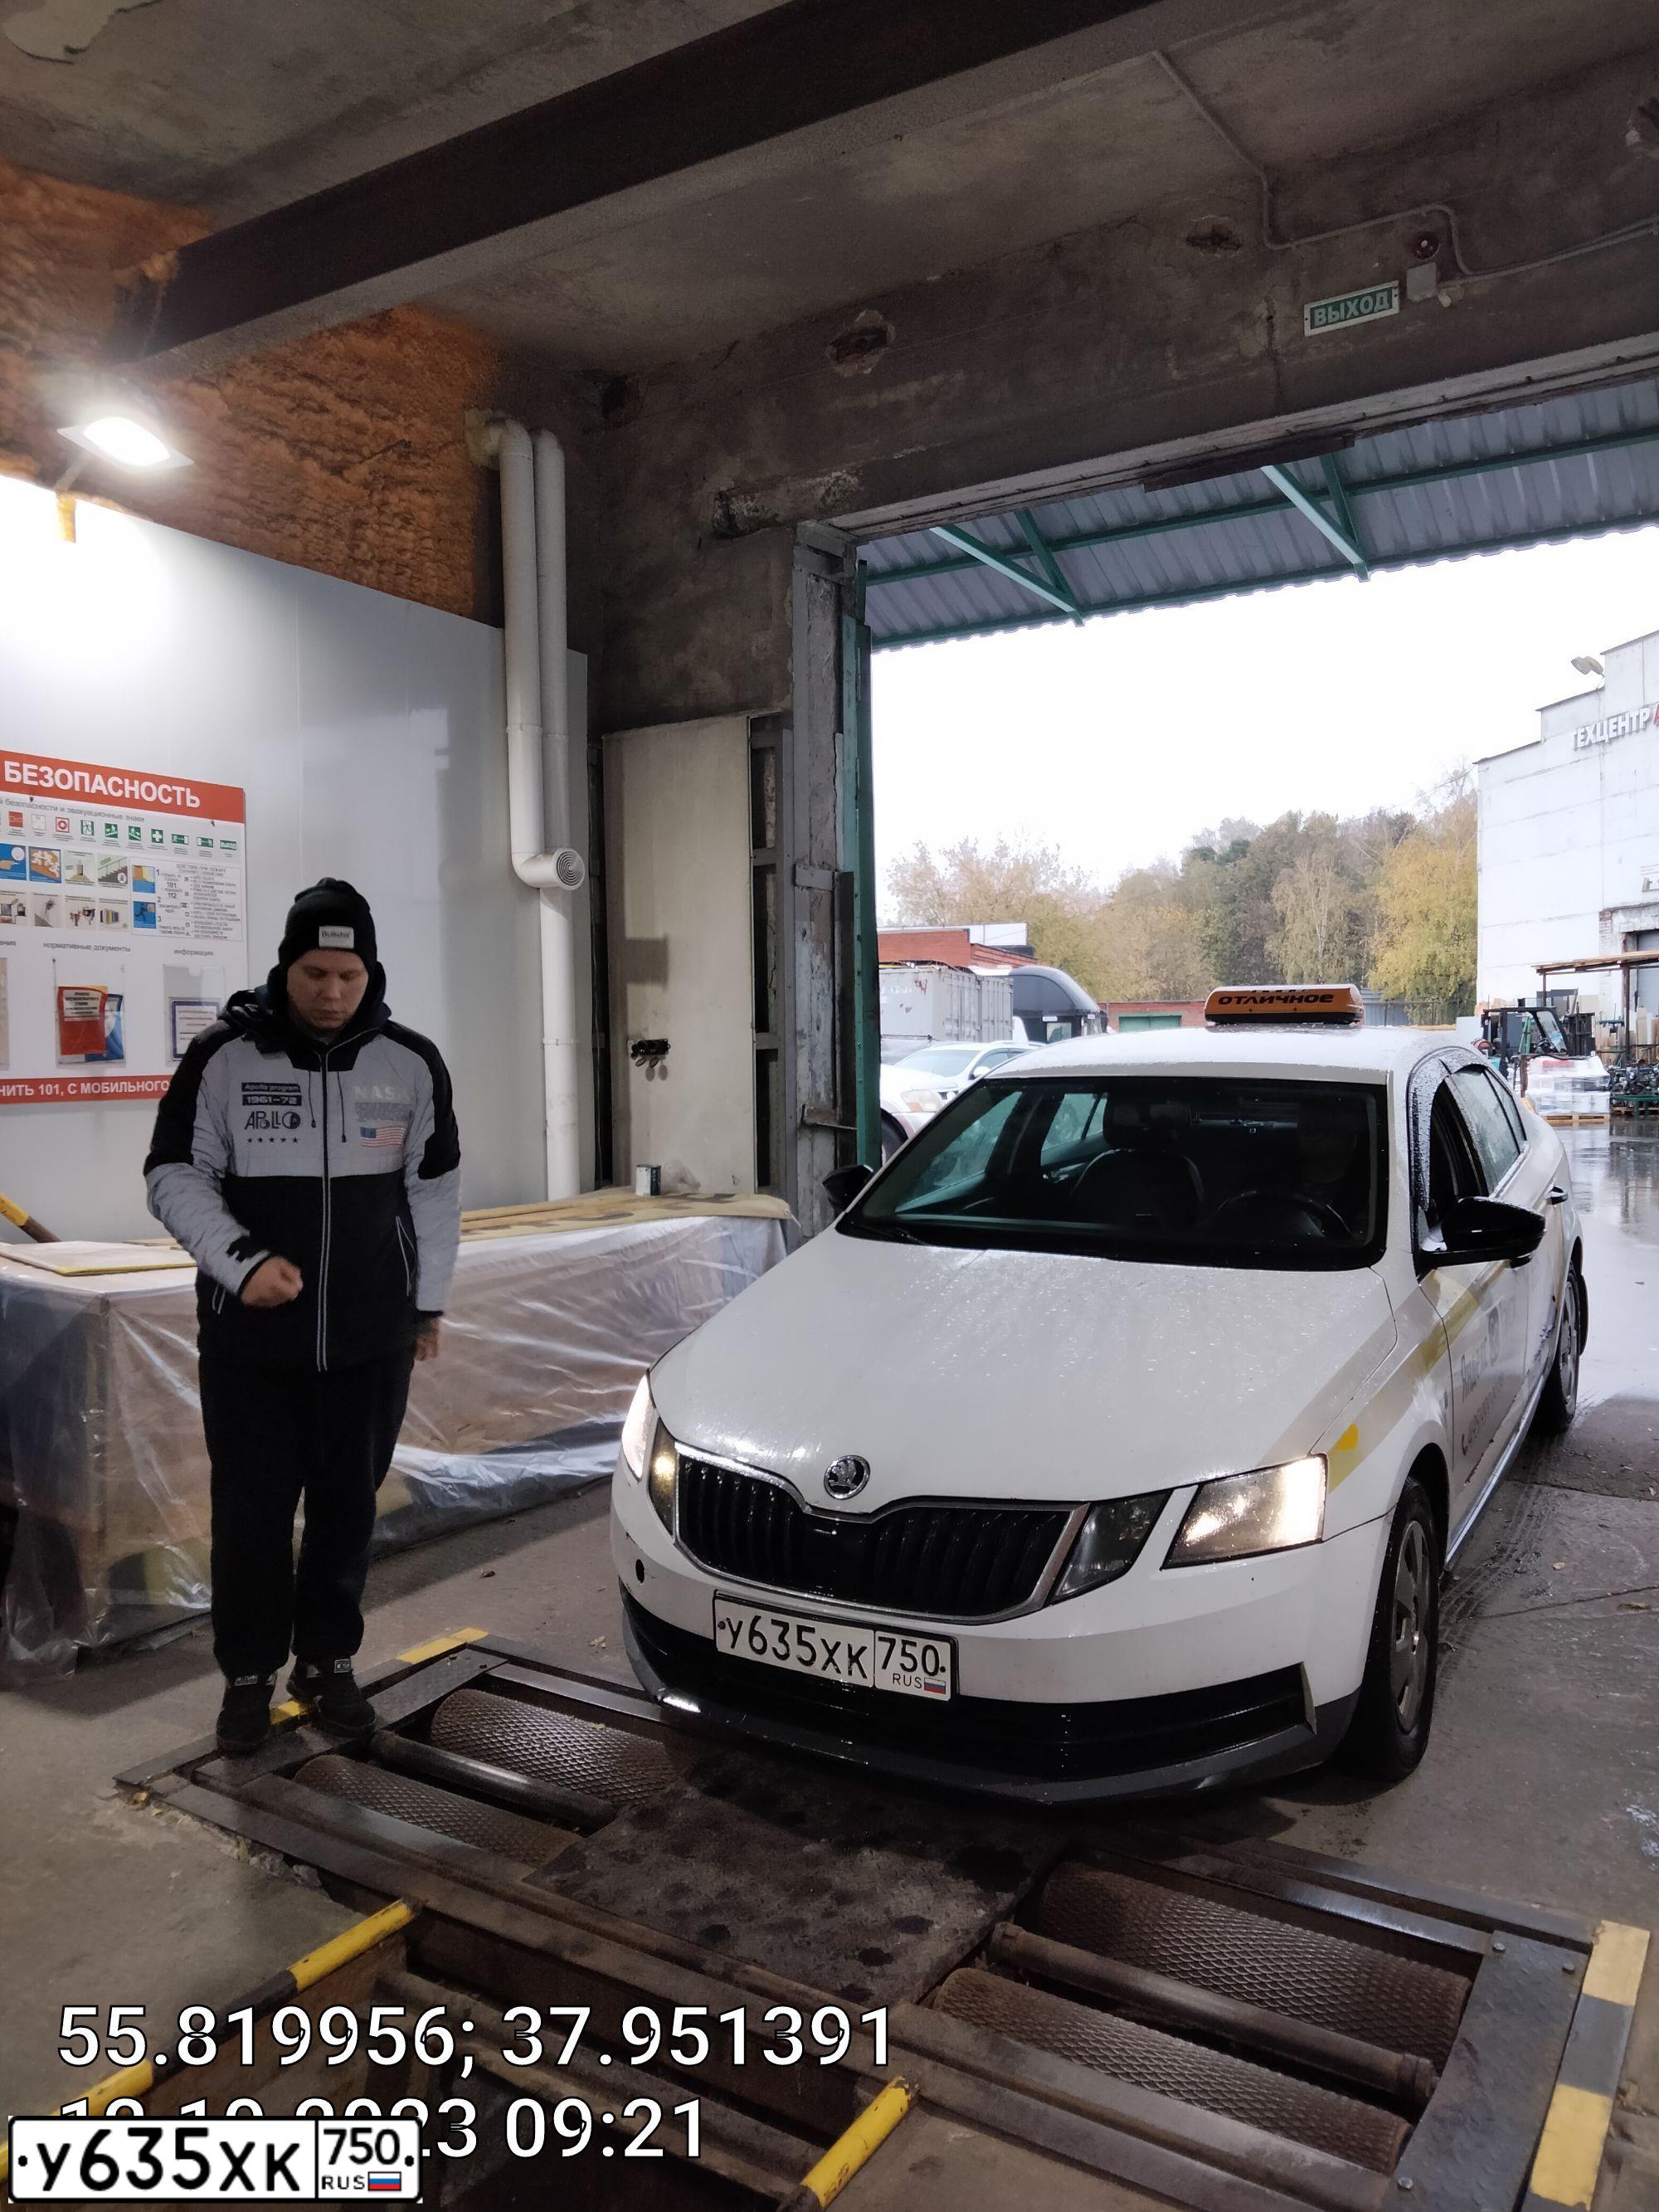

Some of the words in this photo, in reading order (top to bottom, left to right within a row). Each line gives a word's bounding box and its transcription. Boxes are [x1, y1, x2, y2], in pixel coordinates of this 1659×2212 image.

[1313, 290, 1389, 326] ВЫХОД
[4, 760, 201, 807] БЕЗОПАСНОСТЬ
[42, 942, 91, 950] нормативные
[1218, 994, 1335, 1005] ОТЛИЧНОЕ
[39, 1084, 64, 1096] 101,
[67, 1083, 76, 1094] С
[80, 1080, 170, 1094] МОБИЛЬНОГО
[726, 1615, 868, 1680] У635ХК
[878, 1635, 940, 1677] 750
[892, 1673, 922, 1688] RUS
